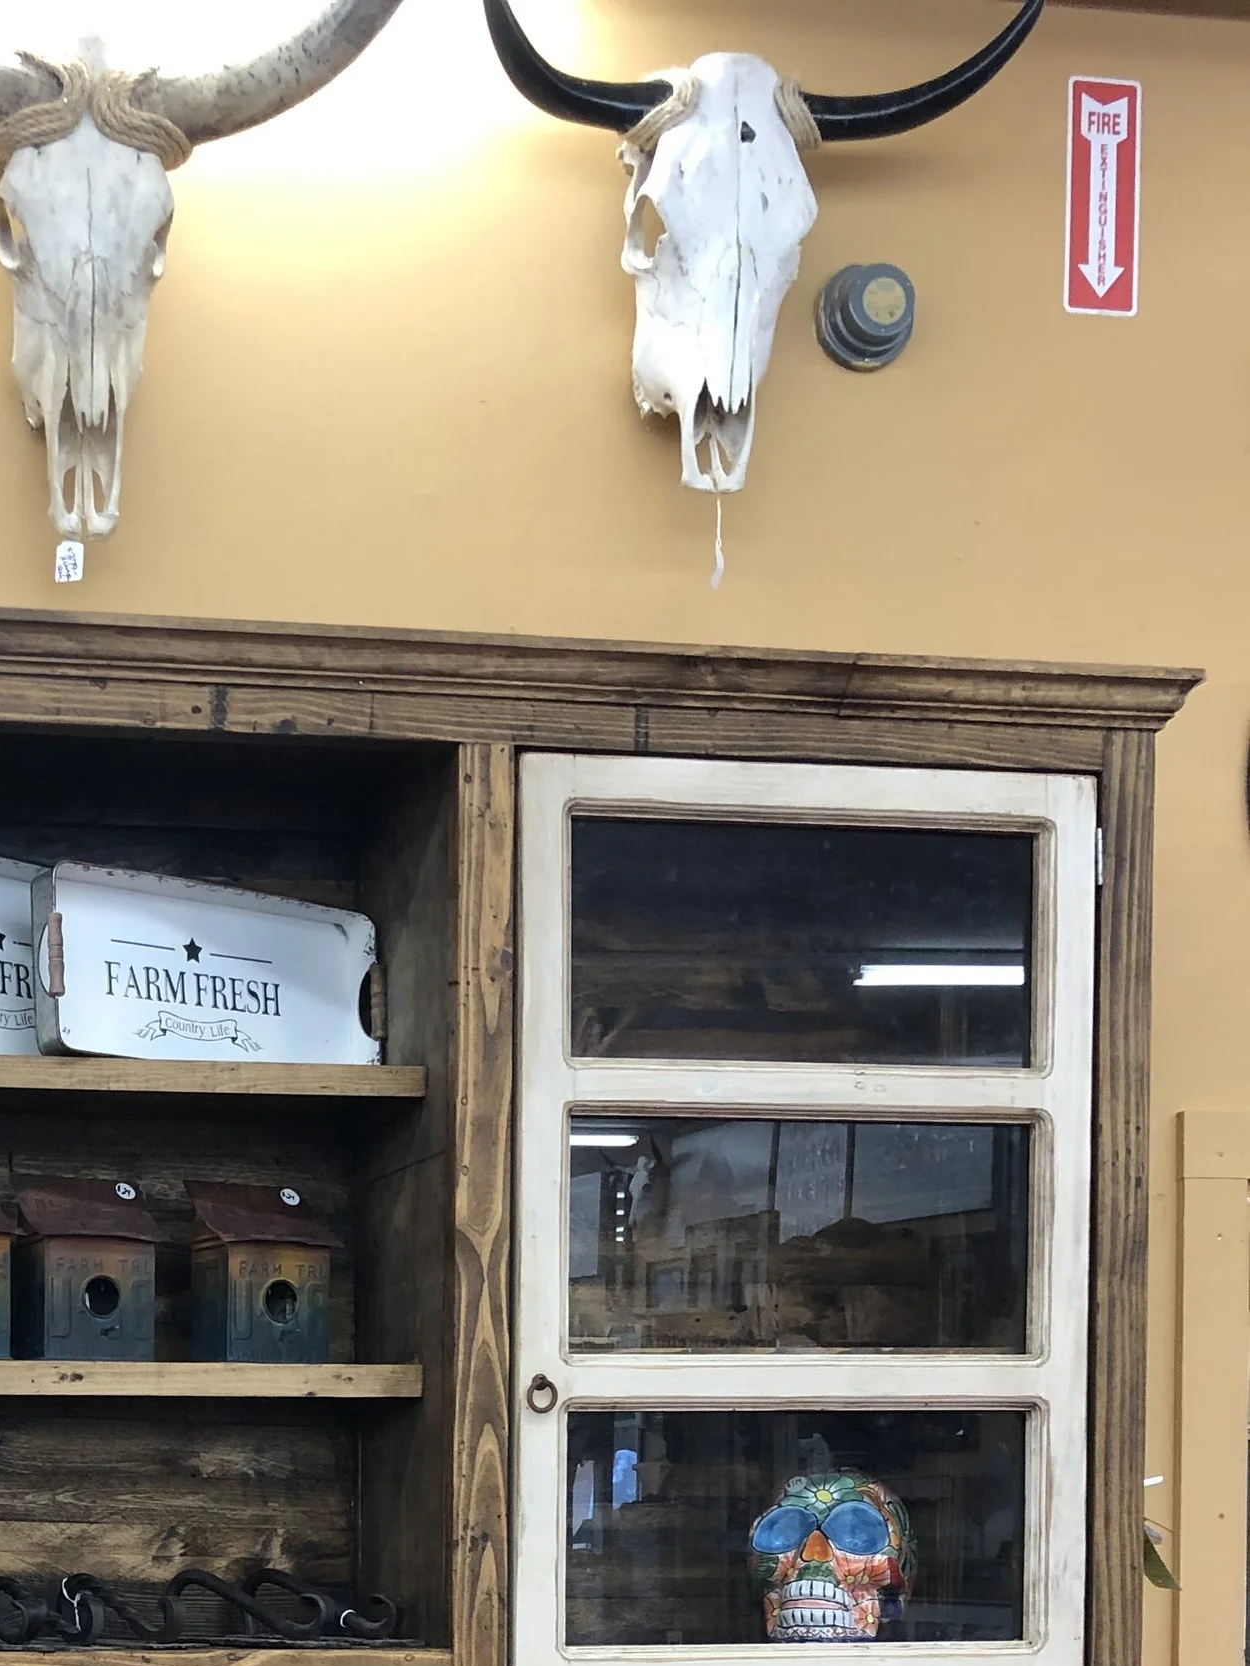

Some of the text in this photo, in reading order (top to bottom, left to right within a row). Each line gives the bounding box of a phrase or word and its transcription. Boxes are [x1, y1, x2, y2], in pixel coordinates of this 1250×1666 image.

[1087, 111, 1121, 135] FIRE
[1097, 143, 1108, 287] EXTINGUISHER
[104, 960, 281, 1017] FARM FRESH
[14, 1013, 34, 1026] Life
[164, 1017, 230, 1037] Country Life
[56, 1257, 105, 1273] FARM
[239, 1261, 282, 1277] FARM
